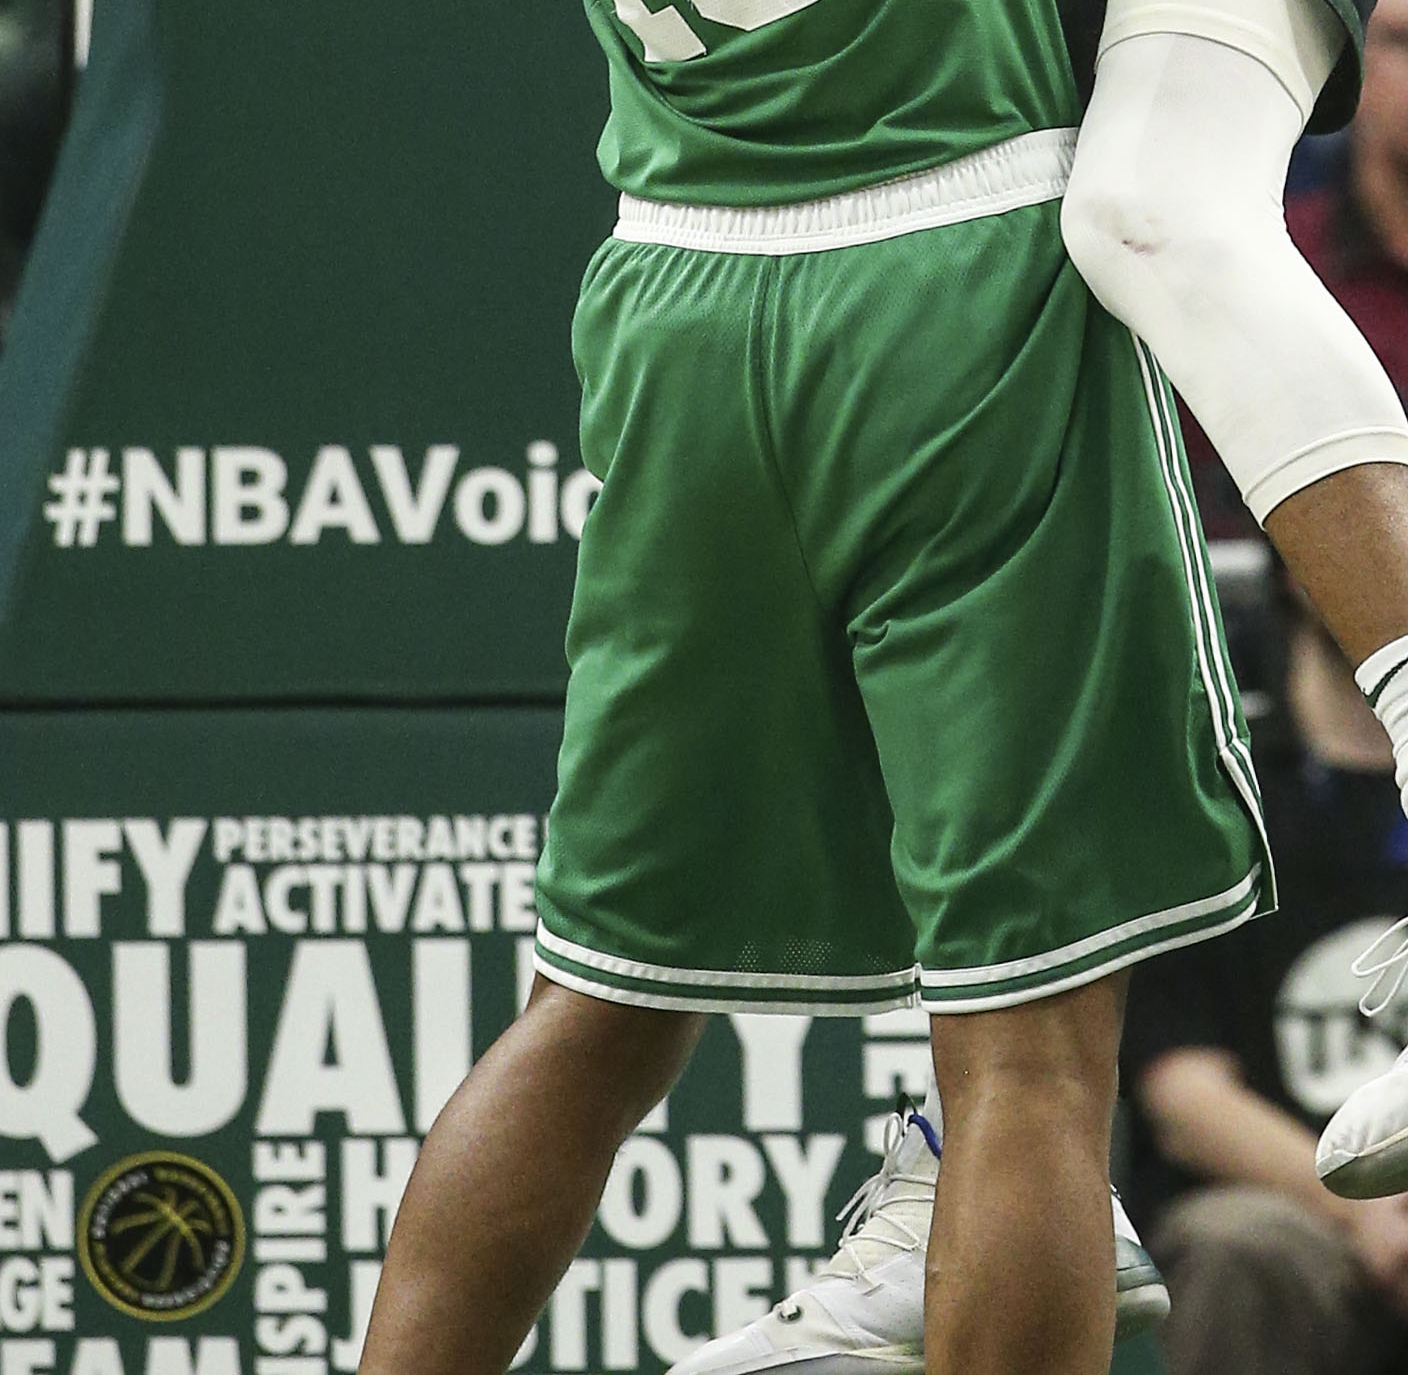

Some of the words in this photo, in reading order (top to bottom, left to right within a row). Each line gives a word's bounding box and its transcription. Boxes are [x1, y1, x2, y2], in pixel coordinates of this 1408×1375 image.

[213, 815, 539, 863] PERSEVERANCE
[0, 817, 207, 939] IFY
[212, 862, 538, 936] ACTIVATE
